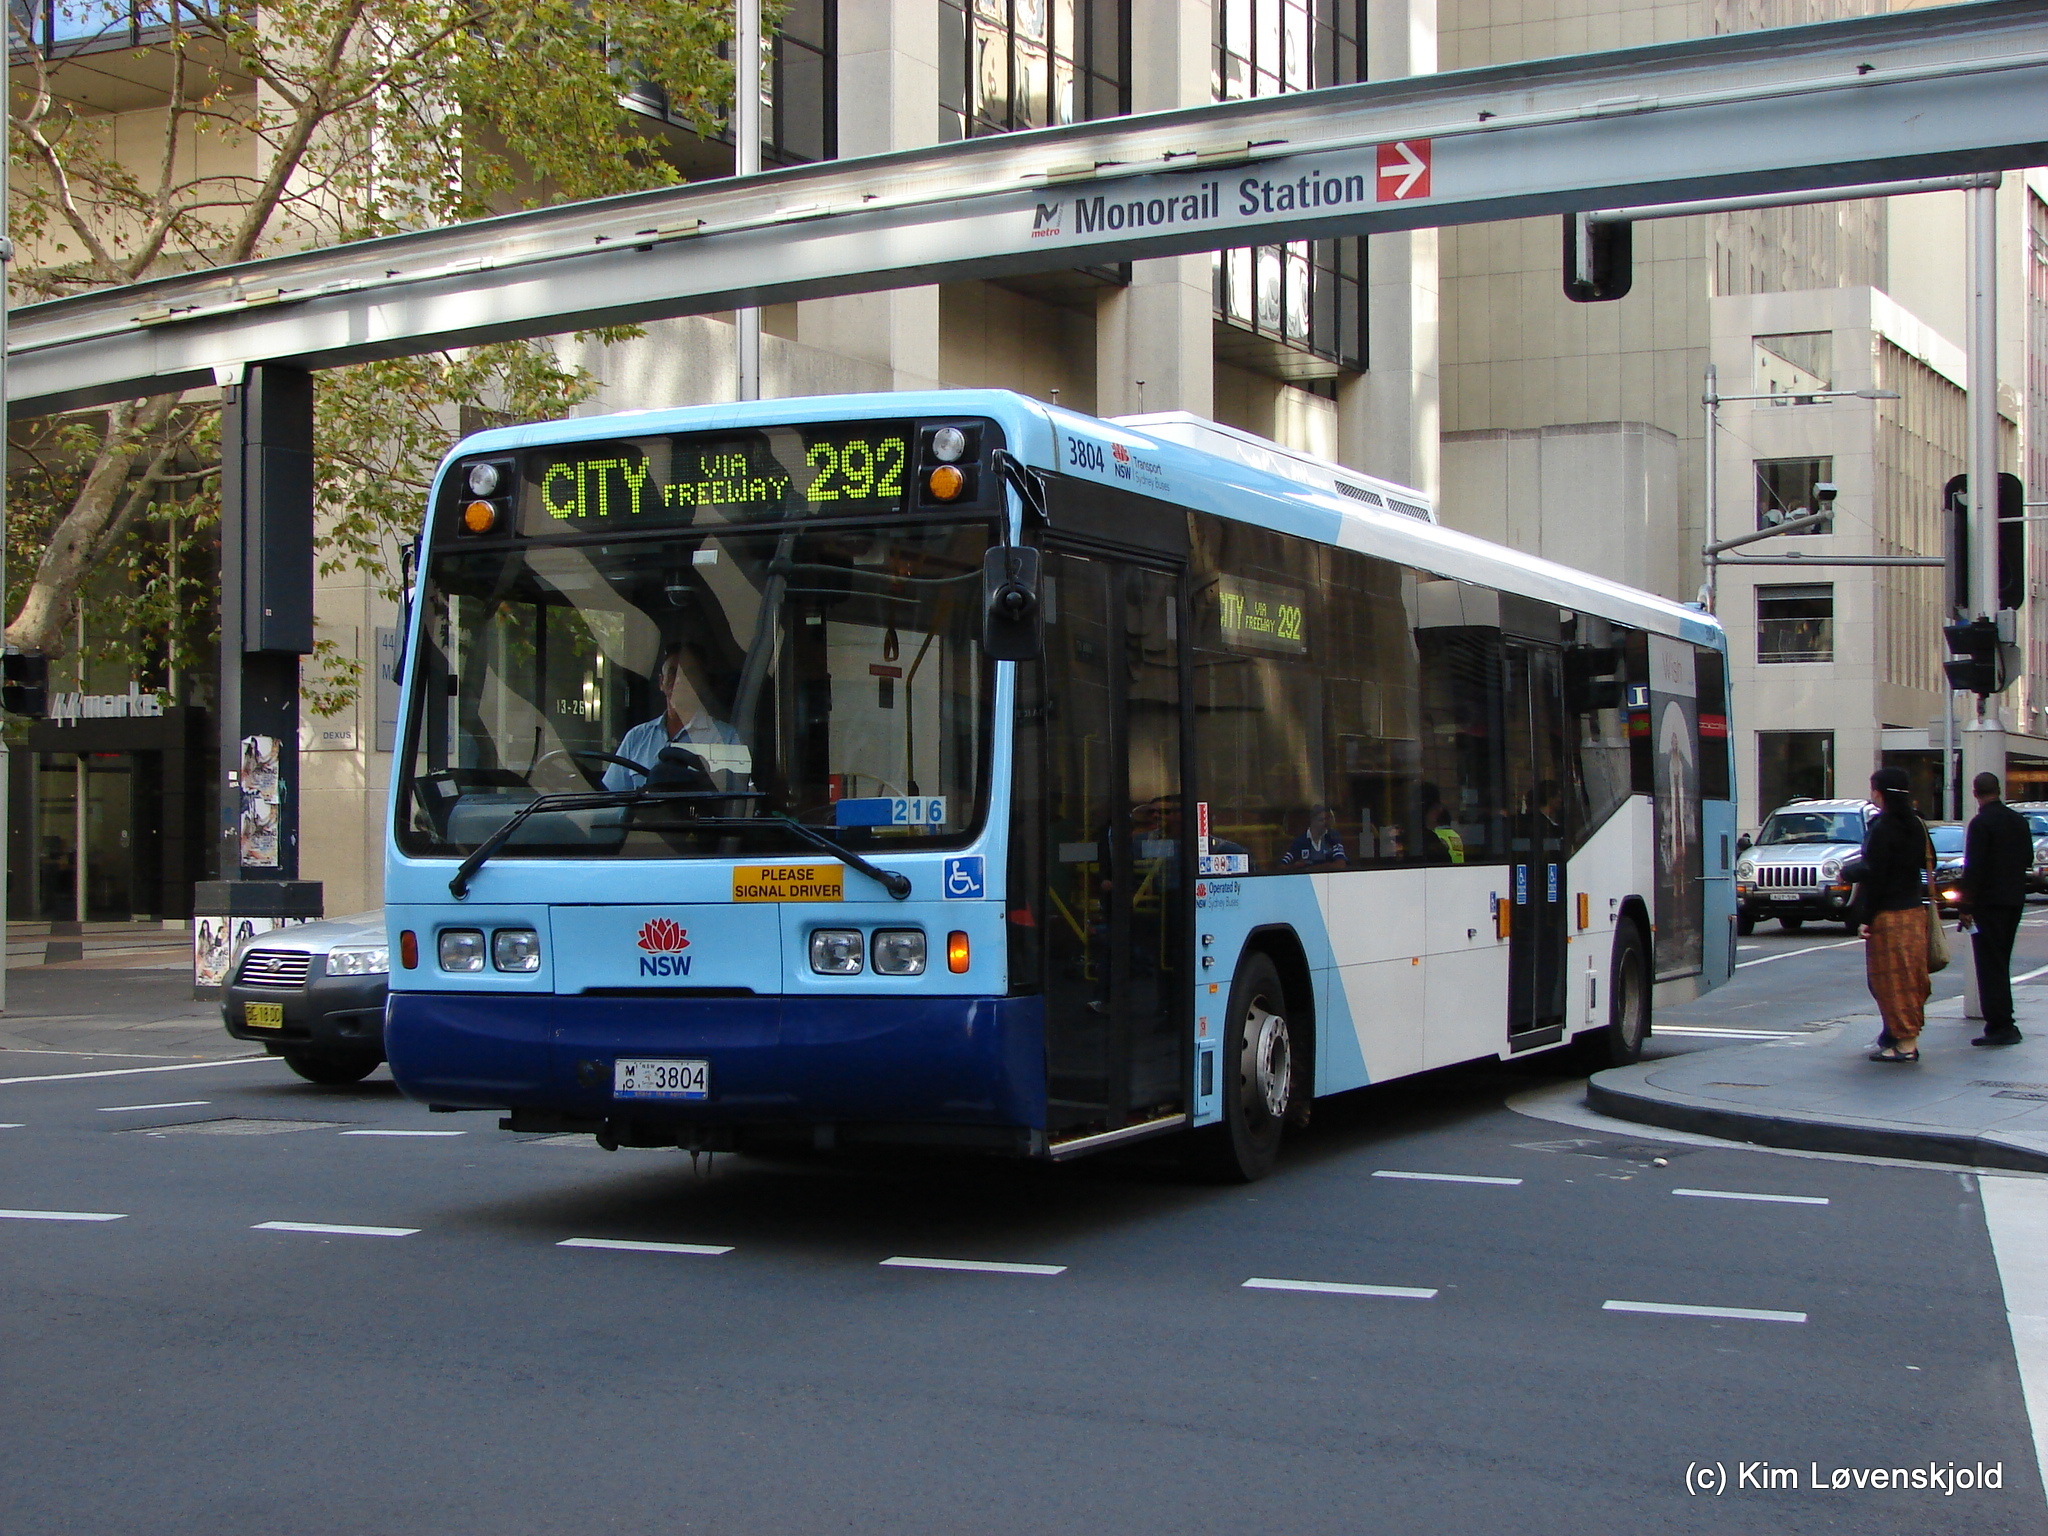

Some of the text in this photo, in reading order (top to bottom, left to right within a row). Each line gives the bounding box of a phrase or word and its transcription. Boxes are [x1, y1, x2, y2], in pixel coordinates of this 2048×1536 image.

[1074, 182, 1218, 234] Monorail
[1239, 170, 1364, 216] Station
[1031, 228, 1060, 238] metro
[700, 453, 747, 478] VIA
[1068, 437, 1104, 473] 3804
[1133, 456, 1162, 475] Transport
[806, 437, 905, 502] 292
[1114, 463, 1131, 480] NSW
[541, 456, 650, 520] CITY
[663, 476, 789, 507] FREEWAY
[1254, 602, 1267, 617] VIA
[1245, 615, 1275, 633] FREEWAY
[1278, 604, 1301, 640] 292
[323, 731, 351, 740] DEXUS
[894, 799, 942, 822] 216
[761, 868, 815, 881] PLEASE
[735, 884, 842, 898] SIGNAL DRIVER
[1208, 881, 1241, 895] Operated By
[640, 956, 692, 977] NSW
[656, 1066, 704, 1089] 3804
